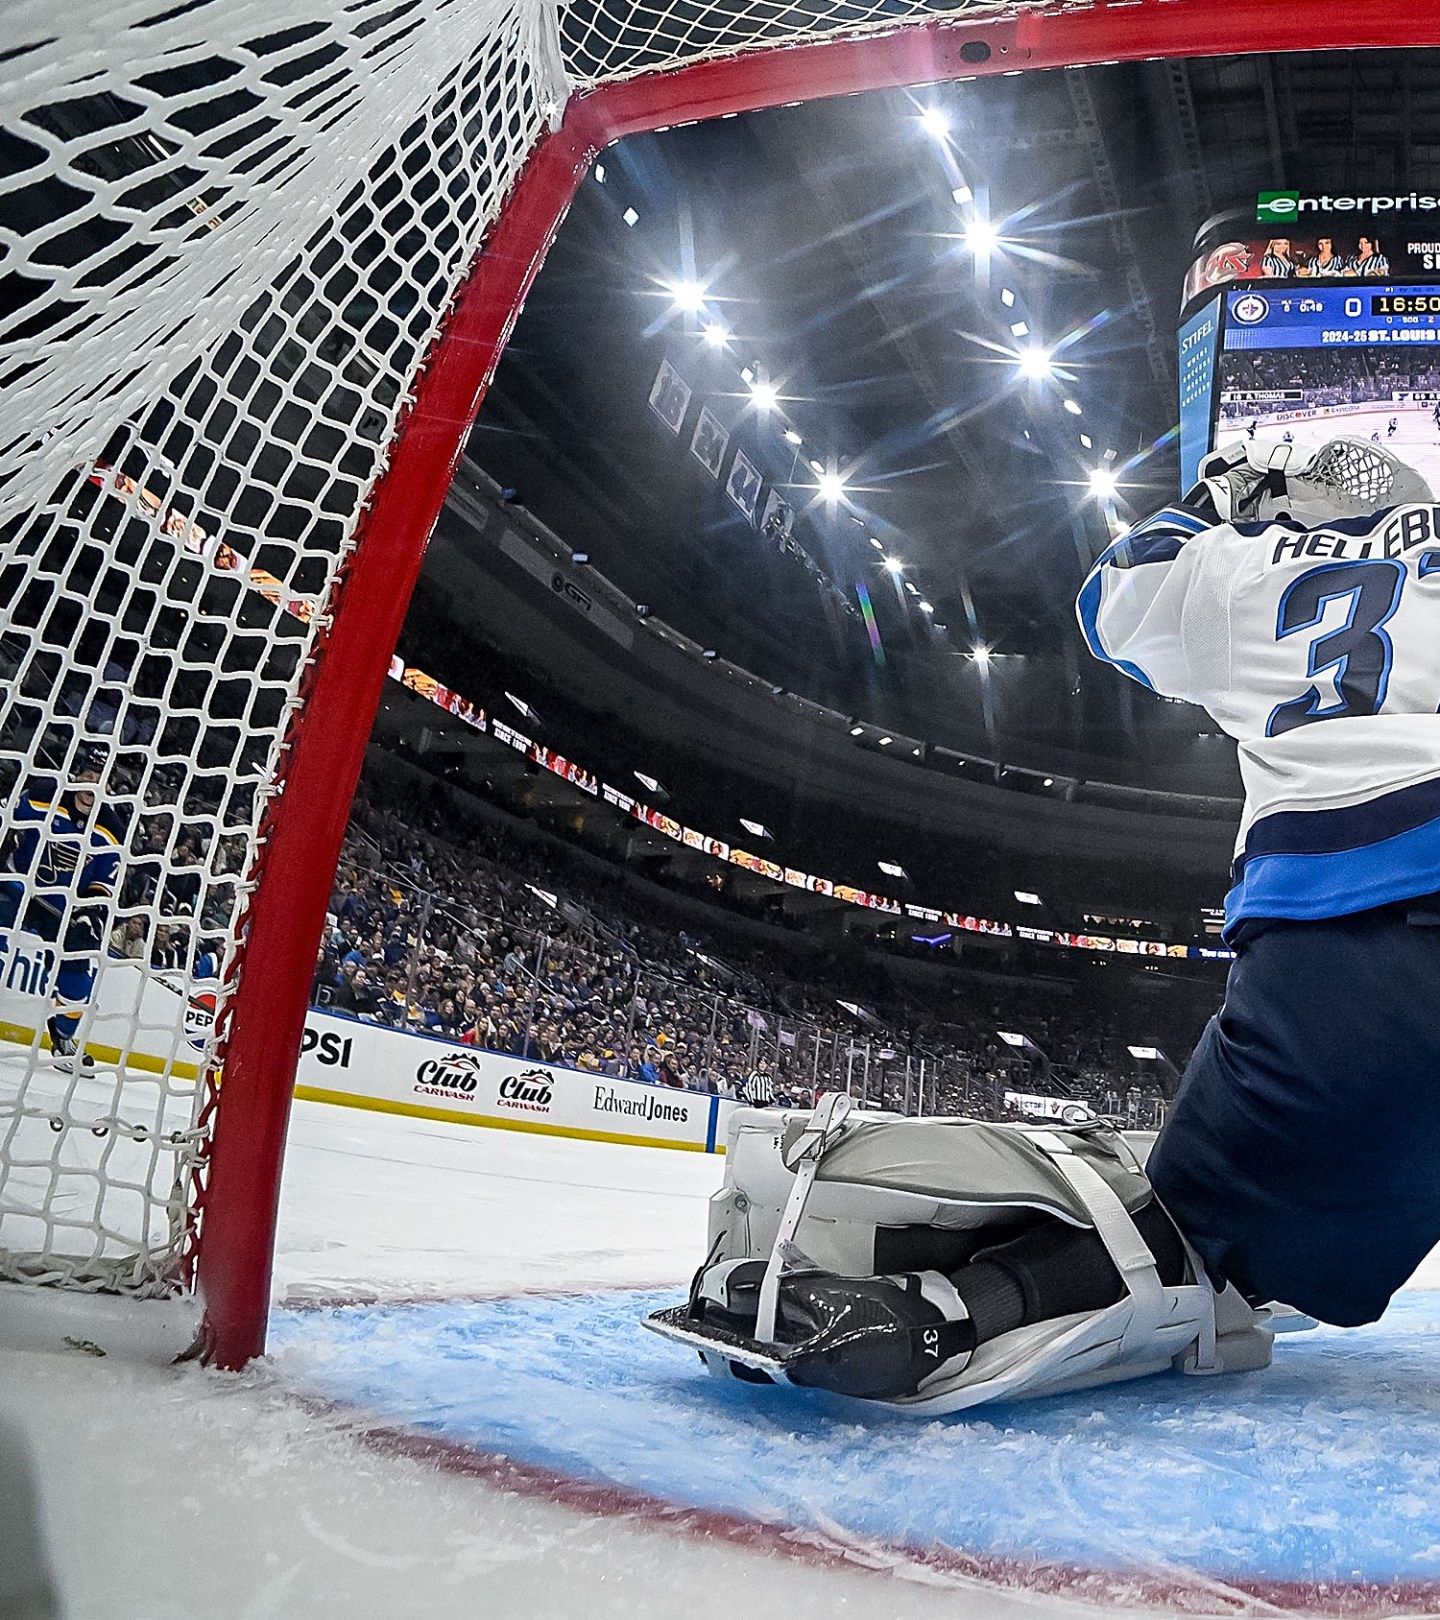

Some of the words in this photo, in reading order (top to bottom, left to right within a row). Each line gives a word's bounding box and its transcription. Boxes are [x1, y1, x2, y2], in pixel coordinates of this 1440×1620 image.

[1344, 298, 1362, 317] 0
[1181, 320, 1214, 355] STIFEL
[1322, 330, 1367, 343] 2024-25
[1391, 329, 1436, 341] LOUIS
[1276, 409, 1317, 421] DISCOVER
[299, 1027, 353, 1068] PSI
[416, 1059, 478, 1093] Club
[413, 1085, 475, 1102] CARWASH
[499, 1075, 553, 1106] Club
[496, 1099, 550, 1114] CARWASH
[923, 1329, 938, 1358] 37
